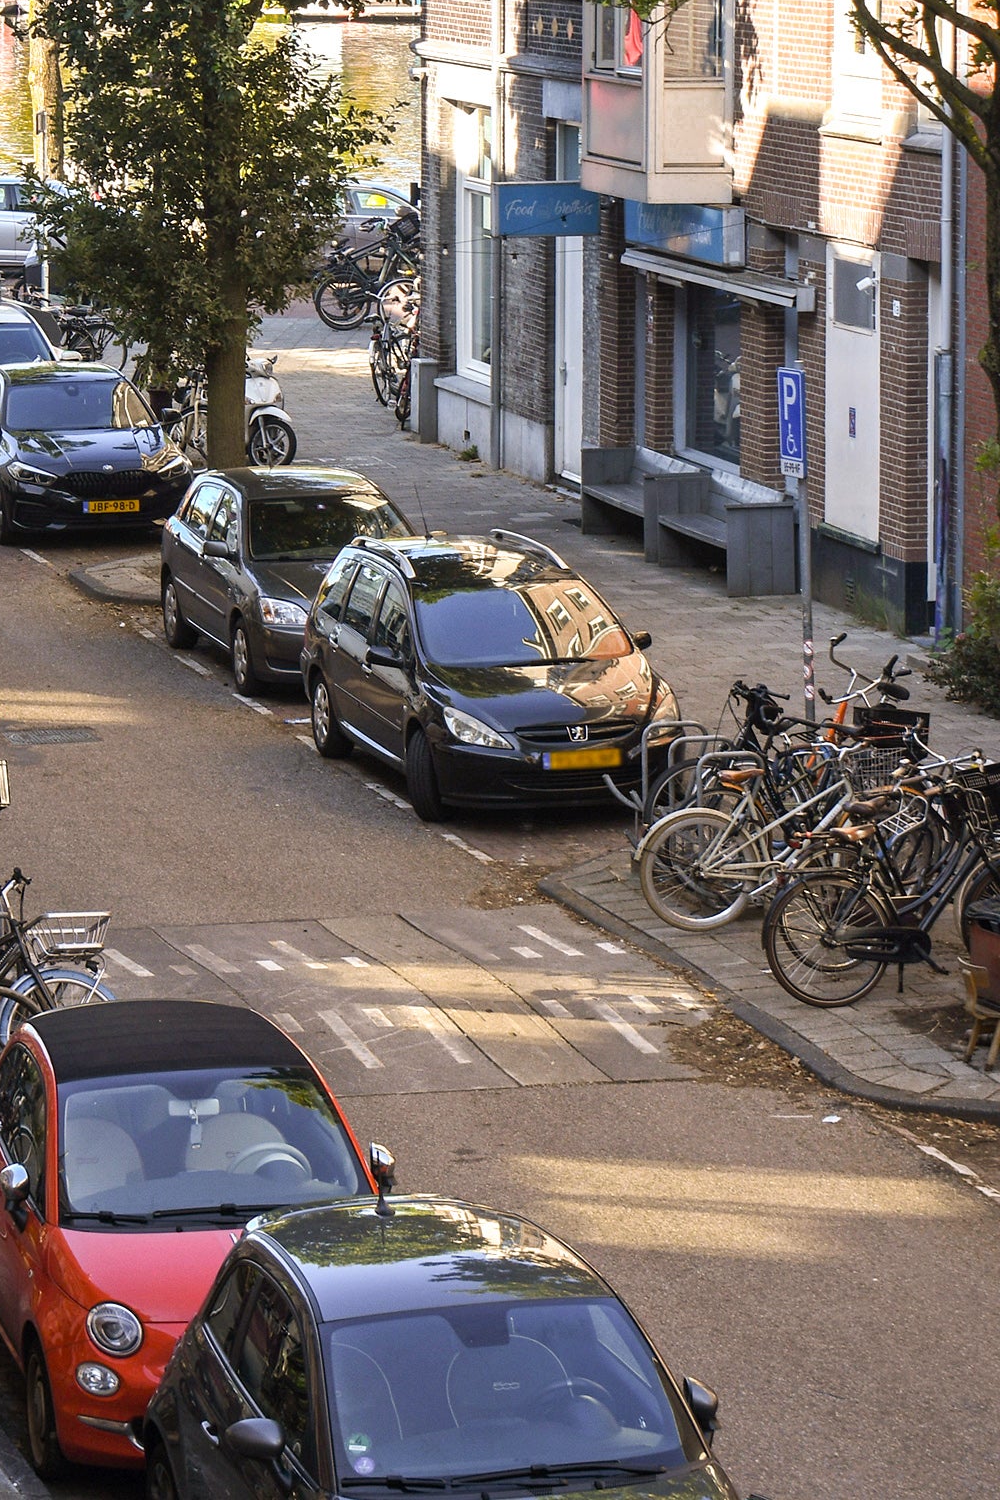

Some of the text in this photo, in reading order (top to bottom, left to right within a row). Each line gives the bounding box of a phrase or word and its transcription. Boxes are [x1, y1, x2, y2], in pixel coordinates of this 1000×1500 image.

[505, 199, 537, 220] Food
[783, 377, 796, 420] P
[91, 501, 136, 511] JBF-98-D
